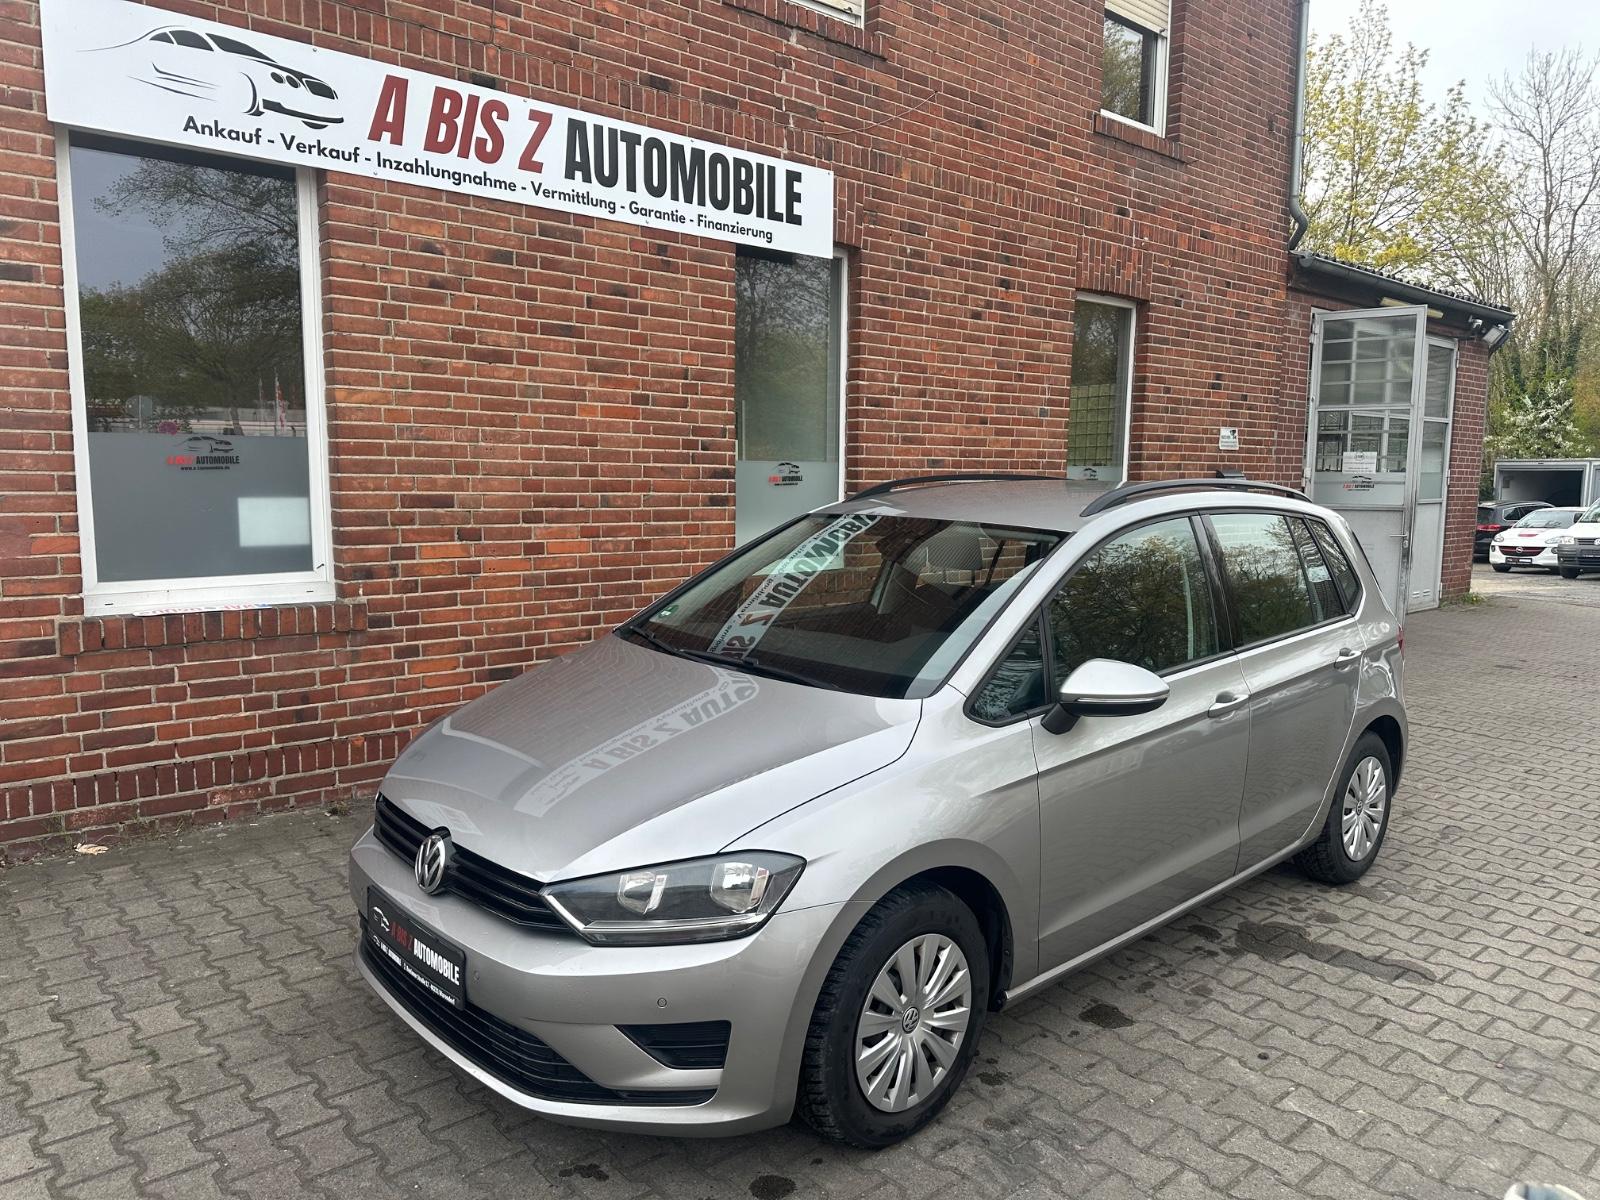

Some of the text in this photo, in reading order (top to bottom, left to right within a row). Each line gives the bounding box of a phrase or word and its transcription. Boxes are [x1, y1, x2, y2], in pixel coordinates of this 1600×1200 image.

[183, 115, 262, 145] Ankauf
[280, 132, 360, 163] Verkauf
[376, 151, 517, 192] Inzahlungnahme
[531, 181, 616, 215] Vermittlung
[629, 201, 686, 225] Garantie
[697, 214, 773, 243] Finanzierung
[368, 74, 802, 226] A BIS Z AUTOMOBILE
[414, 938, 460, 986] AUTOMOBILE
